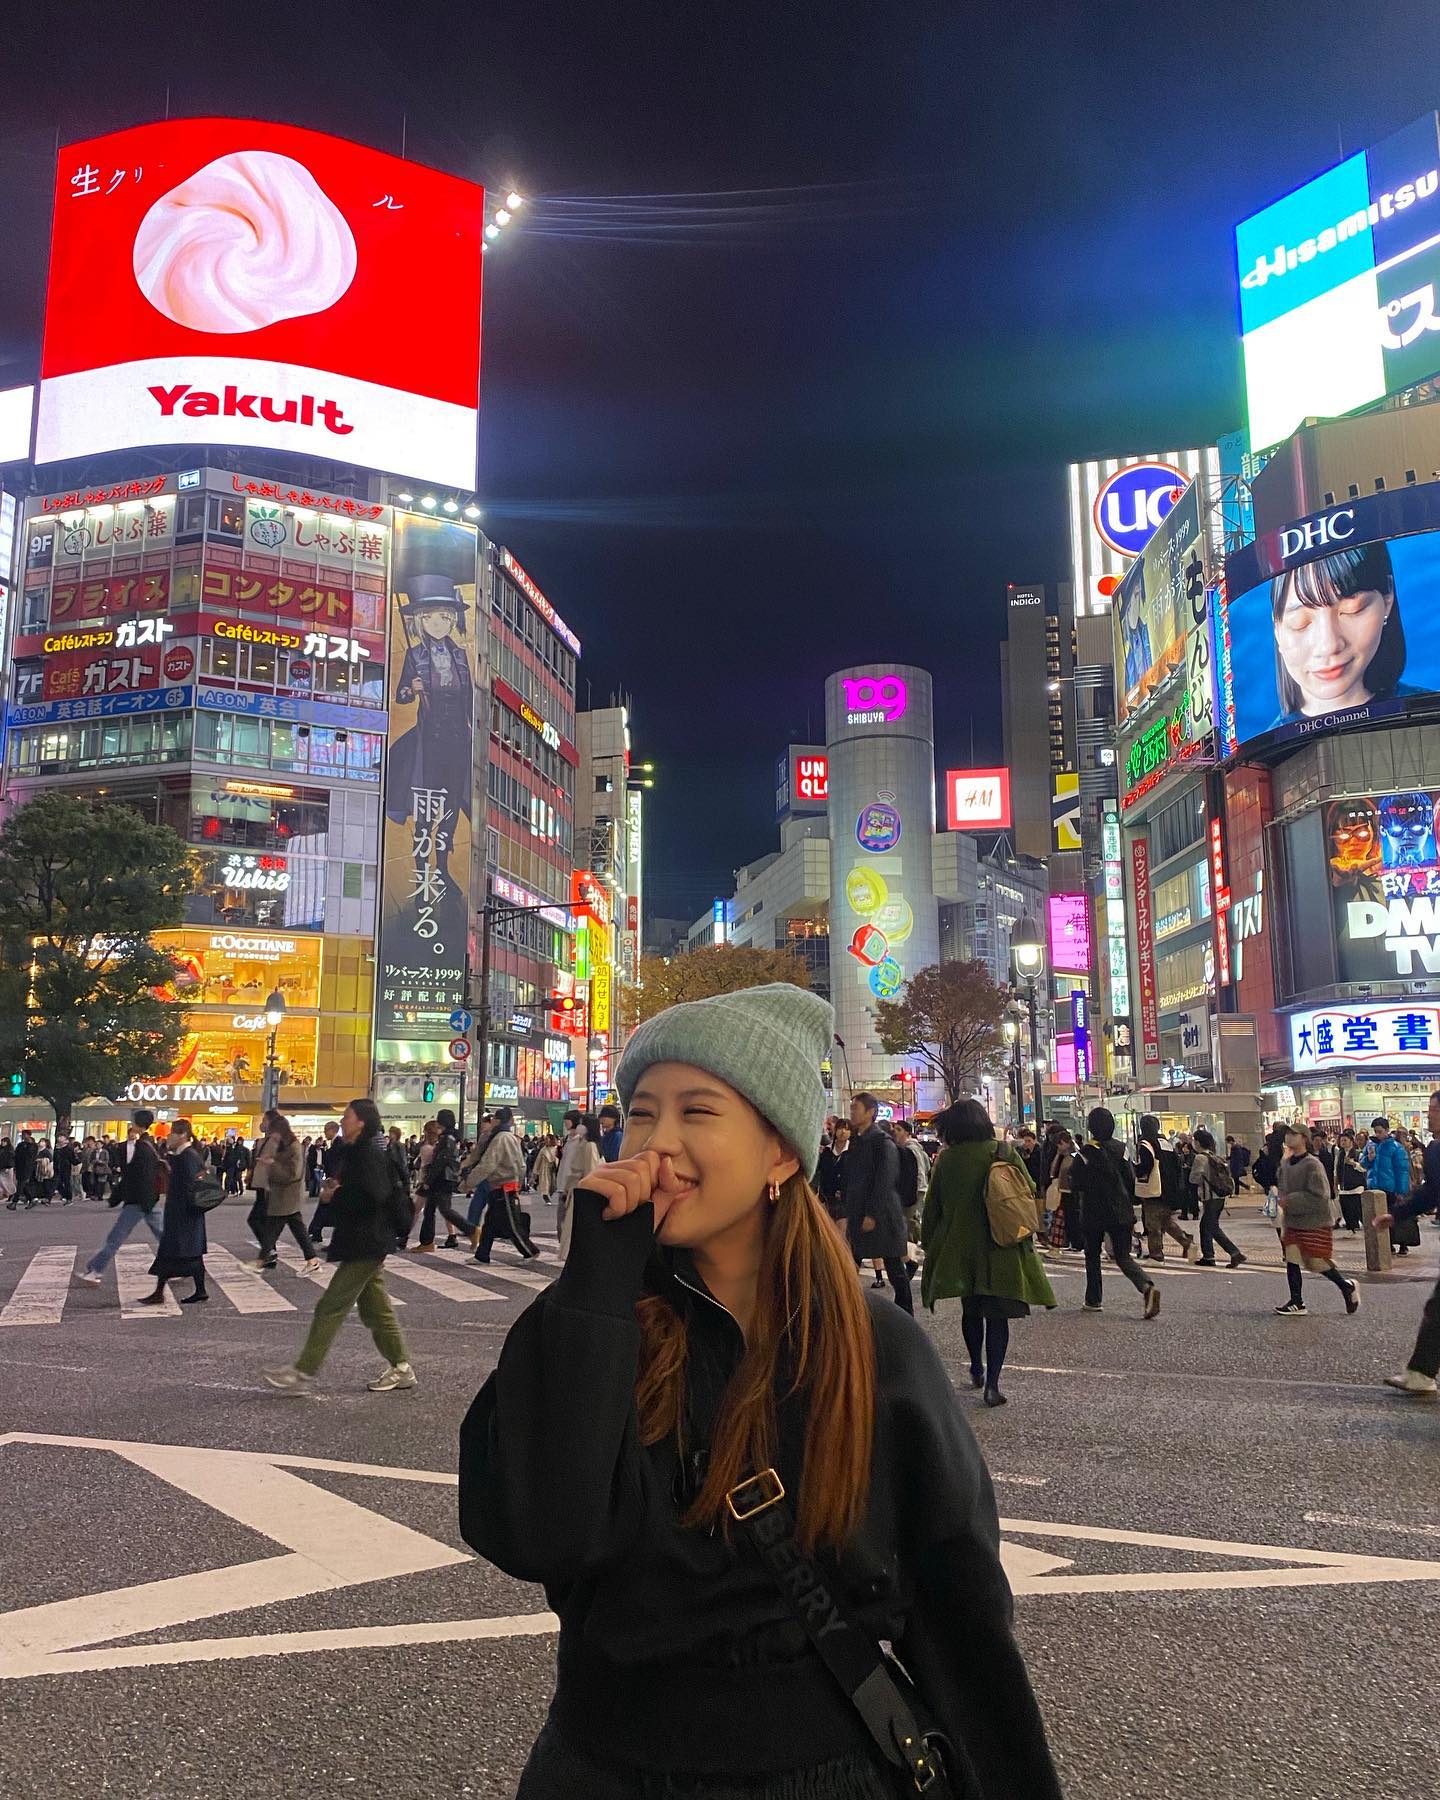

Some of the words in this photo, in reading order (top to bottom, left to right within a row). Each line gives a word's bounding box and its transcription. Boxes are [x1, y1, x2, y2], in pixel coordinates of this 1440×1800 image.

[1241, 170, 1439, 290] Hisamitsu
[147, 384, 354, 435] Yakult
[232, 475, 384, 519] しゃぶしゃぶバイキング
[96, 511, 168, 545] しゃぶ葉
[295, 521, 383, 560] しゃぶ葉
[1279, 509, 1355, 560] DHC
[31, 535, 52, 554] 9F
[53, 576, 168, 620] プライス
[204, 571, 347, 618] コンタクト
[1010, 597, 1041, 606] INDIGO
[116, 618, 174, 648] ガスト
[303, 632, 370, 664] ガスト
[82, 656, 153, 695] ガスト
[167, 661, 191, 673] ガスト
[18, 674, 43, 694] 7F
[842, 675, 907, 722] 109
[57, 691, 161, 720] 英会話イーオン
[204, 690, 248, 708] AEON
[12, 707, 48, 723] AEON
[847, 712, 885, 724] SHIBUYA
[1300, 719, 1323, 733] DHC
[1324, 709, 1370, 730] Channel
[221, 866, 291, 891] Ushi8
[407, 786, 455, 954] 雨が来る。
[211, 935, 295, 952] L'OCCITANE
[385, 964, 463, 980] リバース:1999
[383, 989, 463, 1004] 好評配信中
[233, 1014, 267, 1030] Café
[1076, 997, 1084, 1027] MIZUHO
[544, 1038, 568, 1061] LUSH
[1298, 1013, 1433, 1059] 大盛堂書
